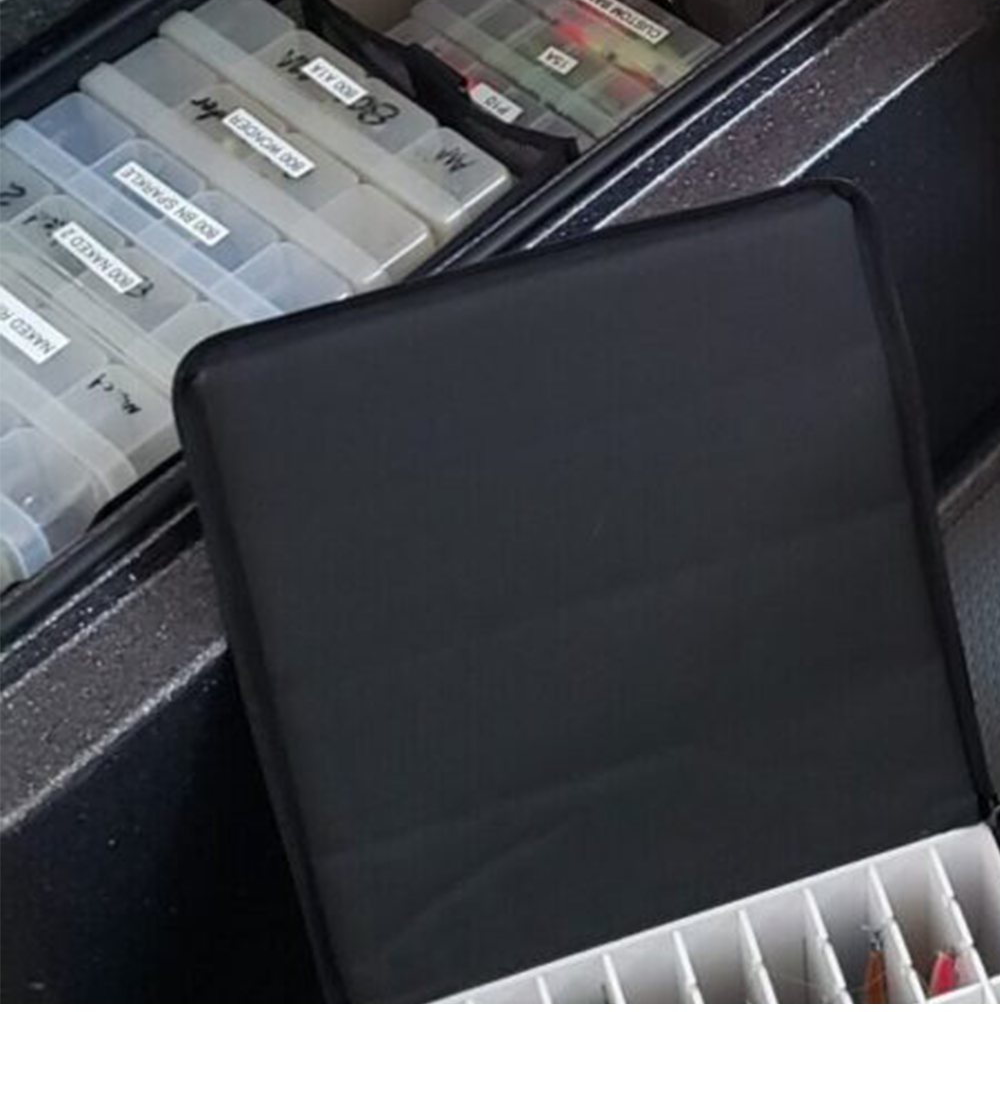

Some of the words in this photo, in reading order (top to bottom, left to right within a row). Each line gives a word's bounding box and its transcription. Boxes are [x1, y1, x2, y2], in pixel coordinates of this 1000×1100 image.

[610, 6, 661, 38] CUSTOM
[229, 114, 284, 153] WONDER
[279, 150, 306, 172] 800
[120, 166, 178, 210] SPARKLE
[173, 205, 197, 223] BN
[60, 228, 75, 239] 2
[193, 219, 220, 240] 800
[70, 236, 112, 272] NAKED
[107, 267, 135, 288] 800
[9, 318, 56, 355] NAKED
